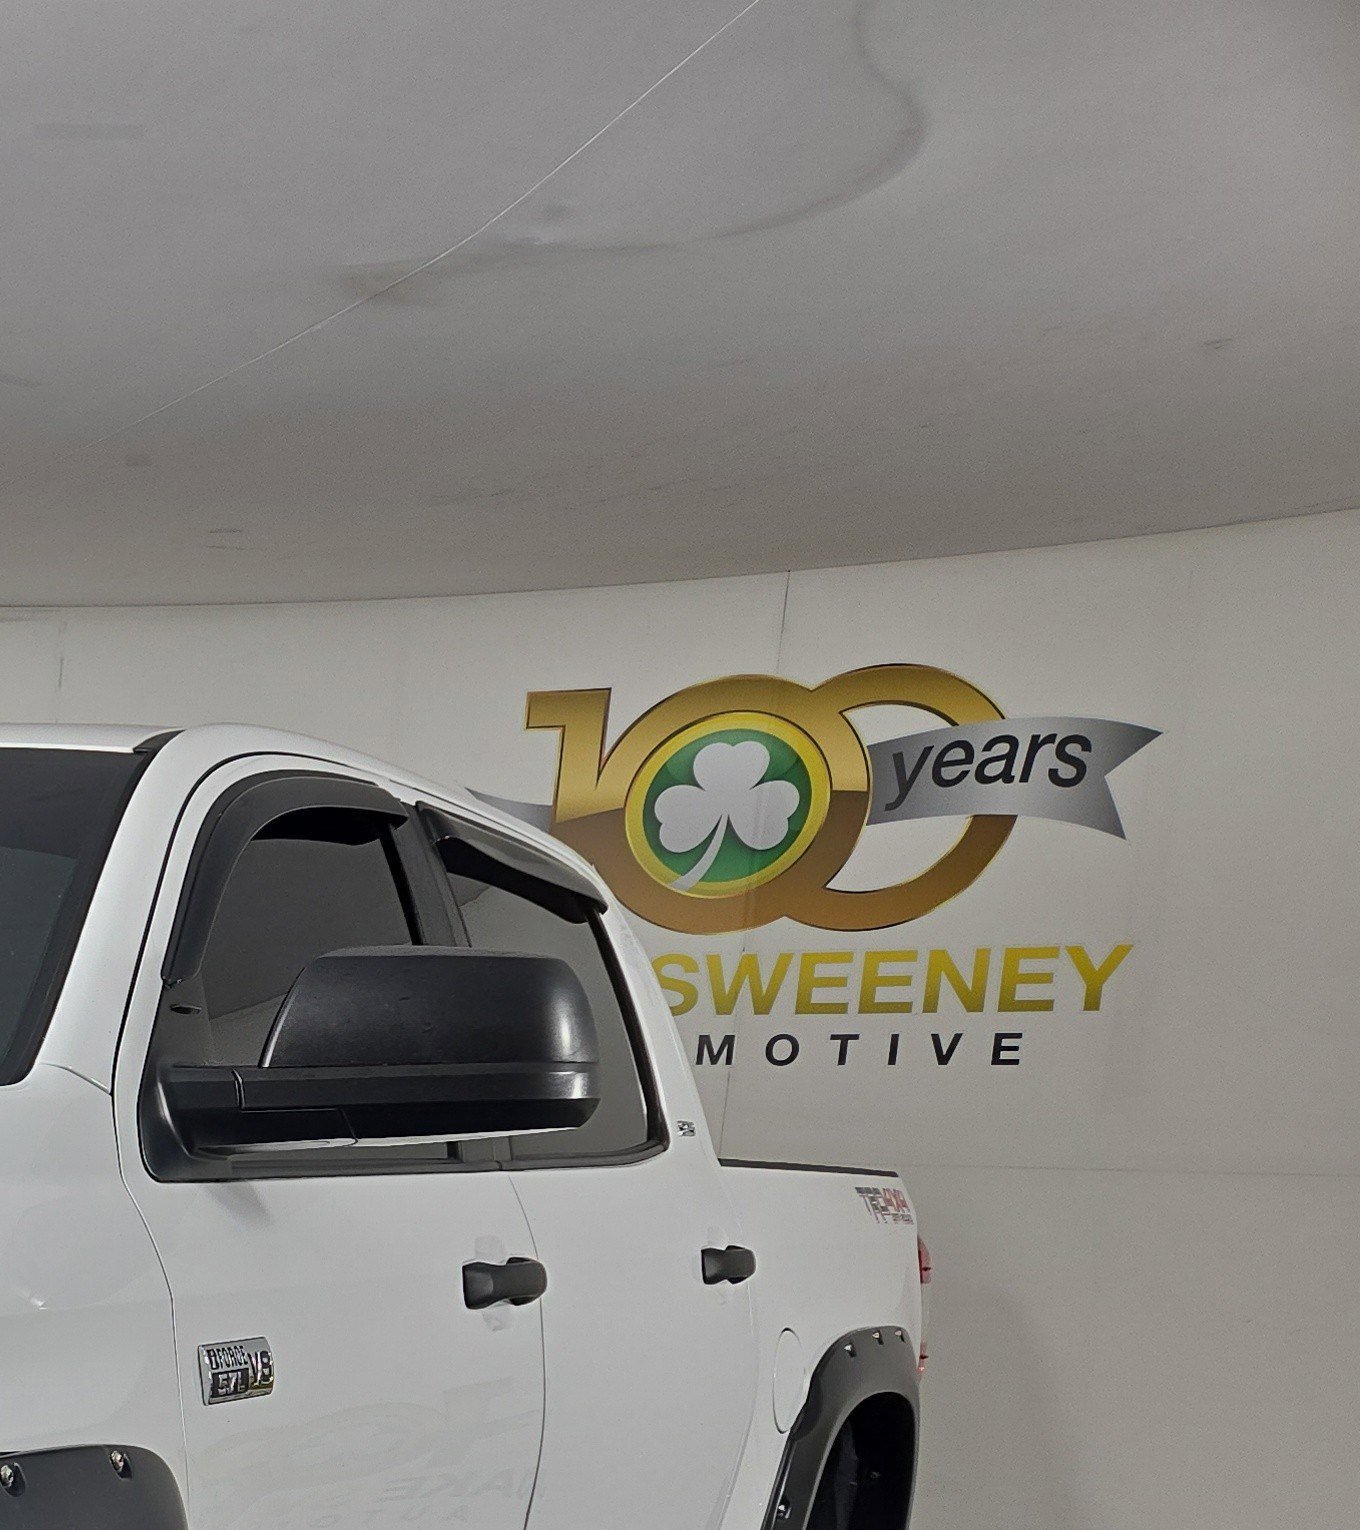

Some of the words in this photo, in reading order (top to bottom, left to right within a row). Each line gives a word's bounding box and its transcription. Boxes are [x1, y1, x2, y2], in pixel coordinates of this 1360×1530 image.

[523, 663, 1018, 935] 100
[884, 730, 1092, 812] years
[651, 943, 1134, 1017] SWEENEY
[695, 1032, 1024, 1067] MOTIVE
